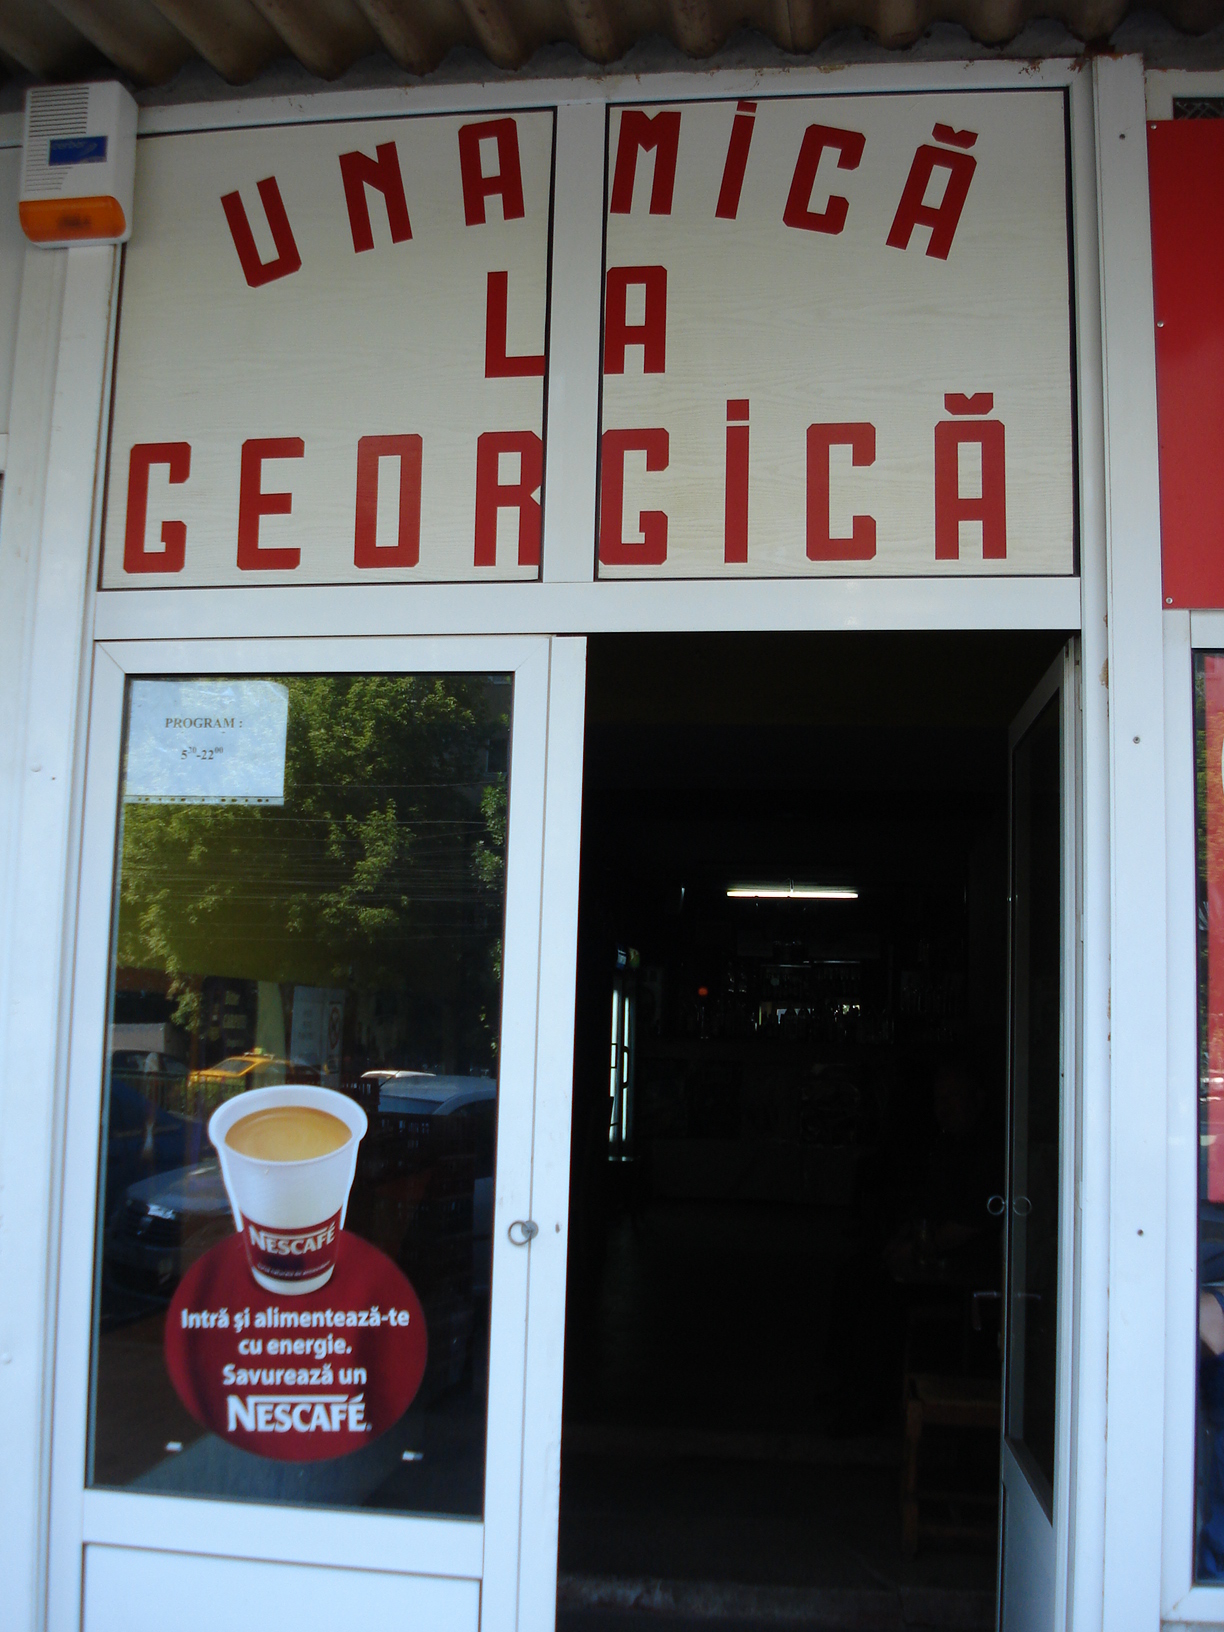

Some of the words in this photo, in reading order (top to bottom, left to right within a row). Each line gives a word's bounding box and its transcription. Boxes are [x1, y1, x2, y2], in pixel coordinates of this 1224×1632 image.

[221, 118, 525, 288] UNA
[485, 266, 667, 378] LA
[249, 1222, 336, 1255] NESCAFÉ
[181, 1307, 229, 1328] Intră
[254, 1306, 410, 1328] alimentează-te
[238, 1338, 262, 1355] cu
[266, 1333, 352, 1359] energie.
[222, 1363, 334, 1385] Savurează
[338, 1367, 367, 1385] un
